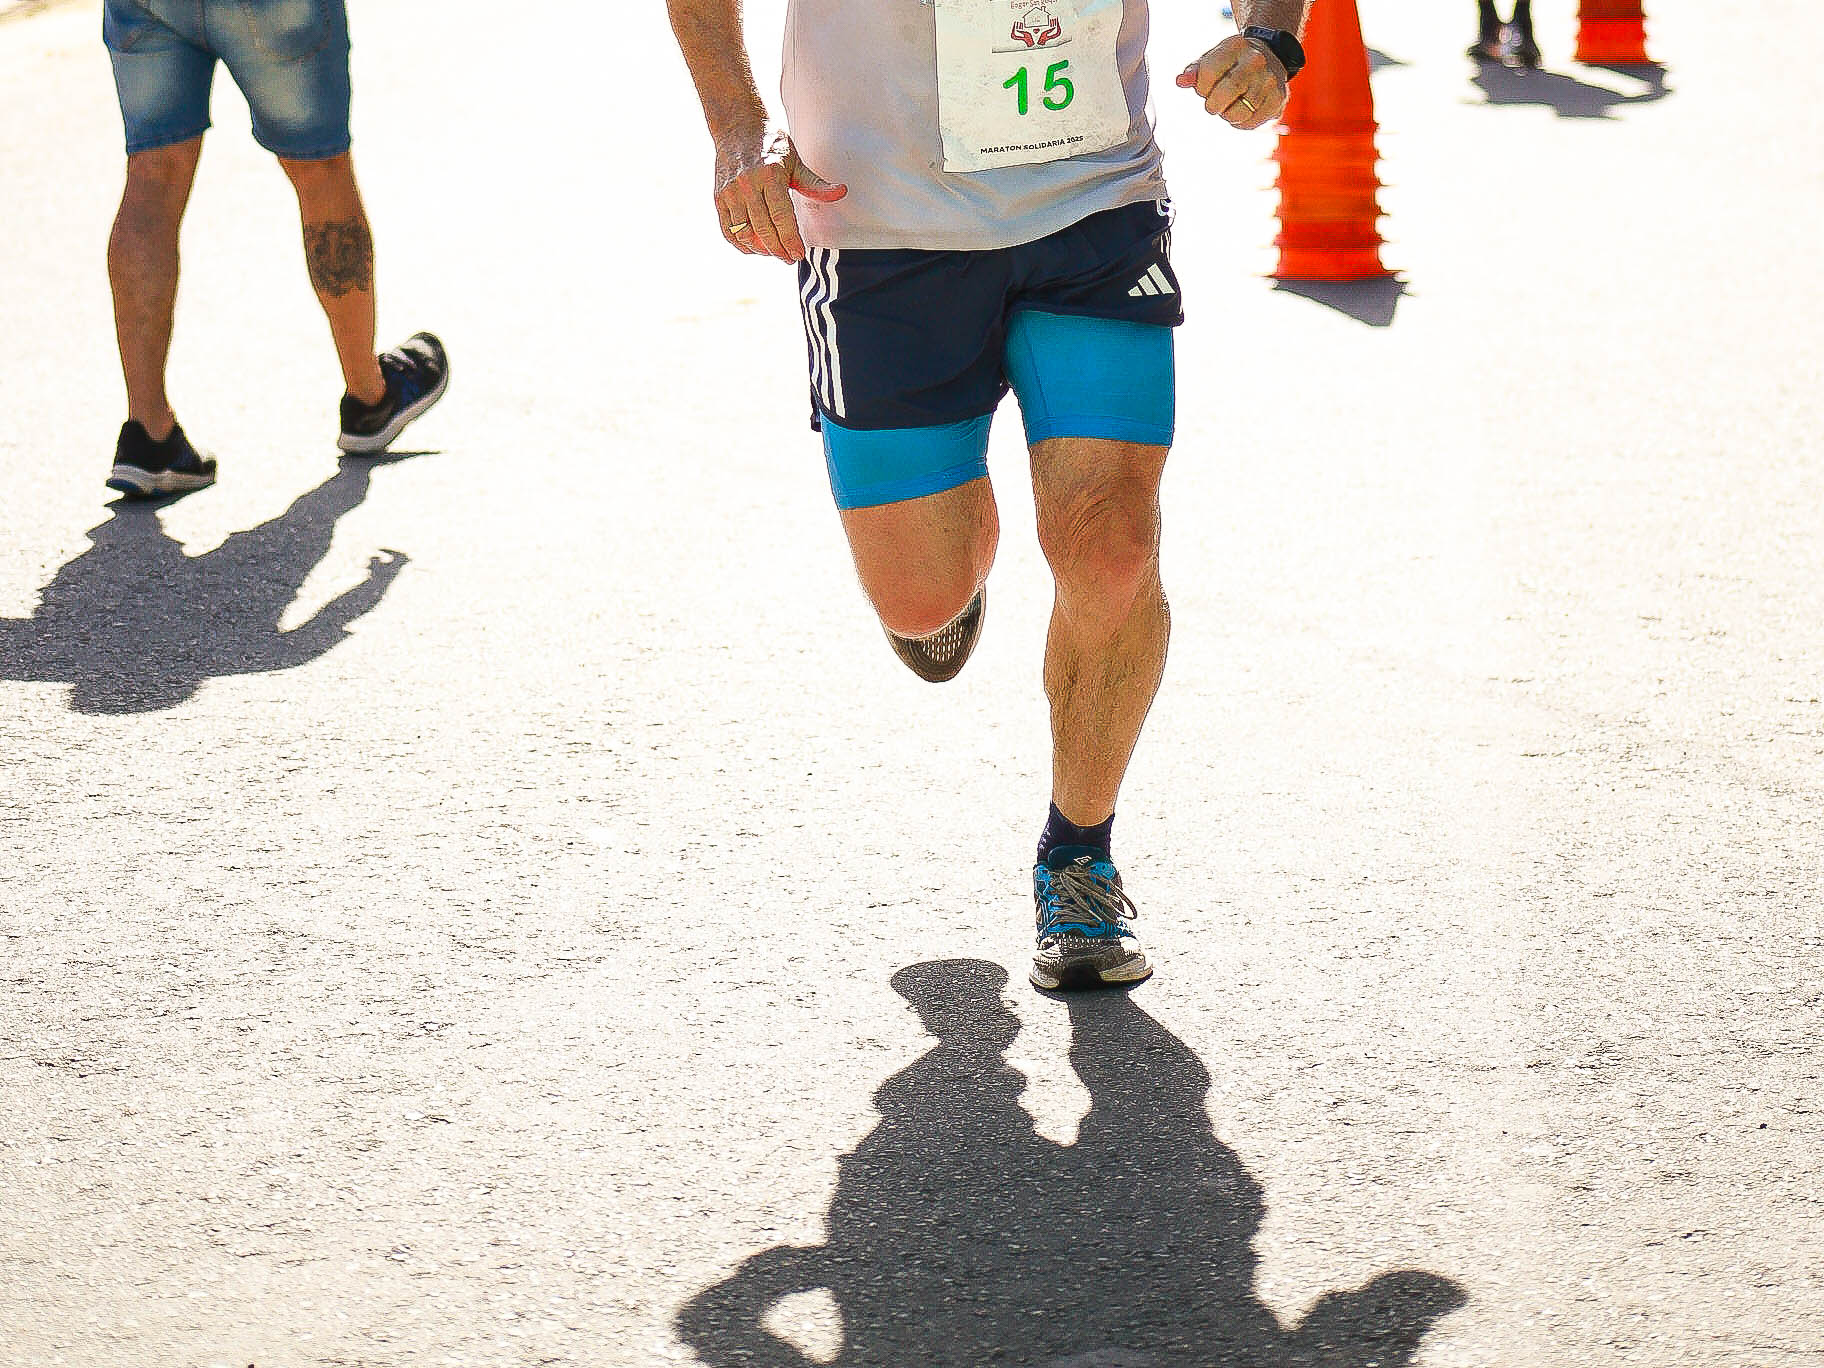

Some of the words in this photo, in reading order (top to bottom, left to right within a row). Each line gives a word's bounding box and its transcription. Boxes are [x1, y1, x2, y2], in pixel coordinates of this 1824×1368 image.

[1002, 59, 1074, 115] 15
[980, 145, 1022, 155] MARATON
[1023, 138, 1066, 151] SOLIDARIA
